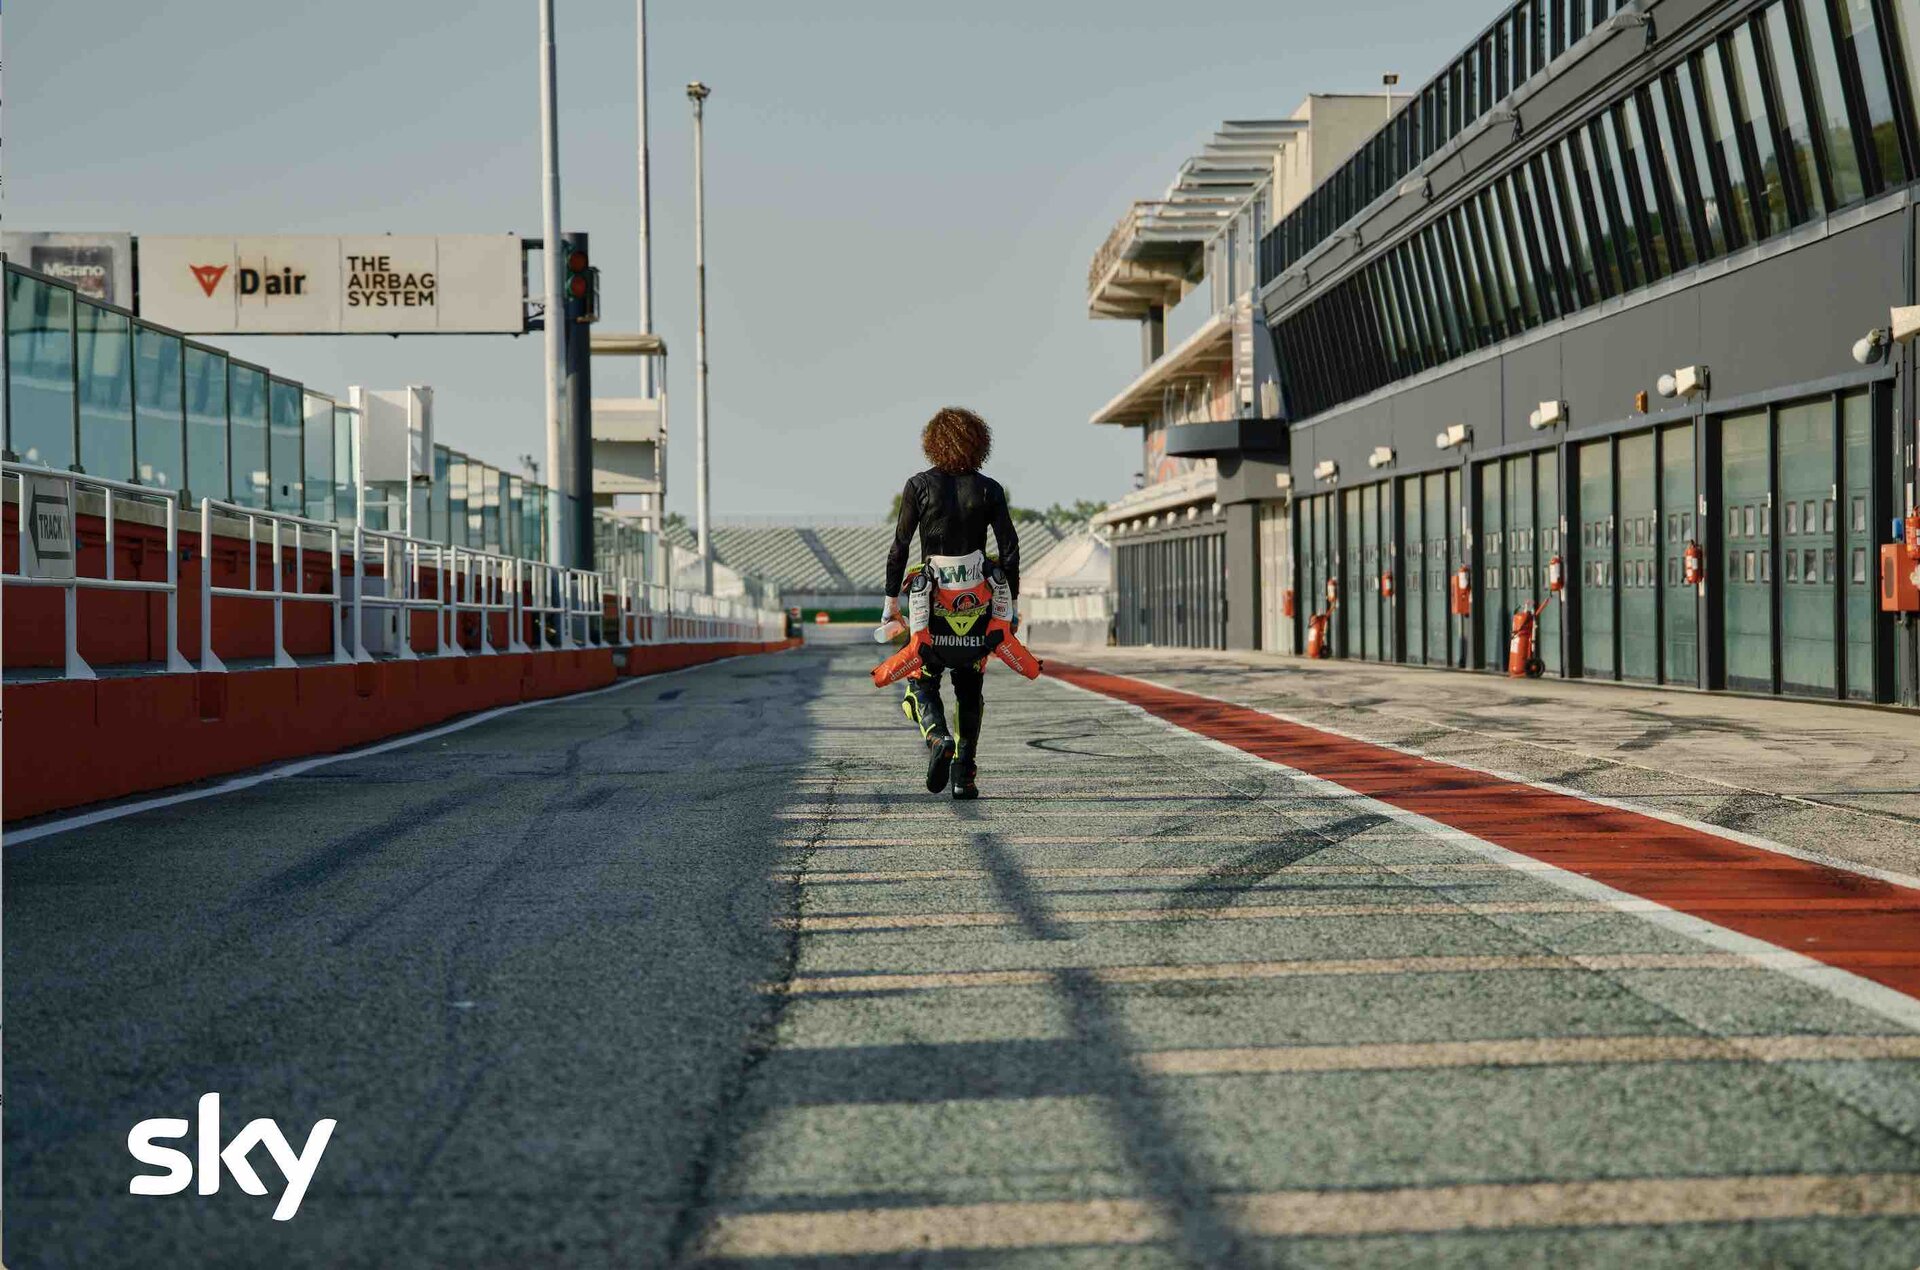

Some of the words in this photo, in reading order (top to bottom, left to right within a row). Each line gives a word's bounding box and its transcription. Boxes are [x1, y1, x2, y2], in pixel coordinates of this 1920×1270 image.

[42, 261, 105, 277] Misano
[347, 255, 391, 272] THE
[348, 273, 435, 290] AIRBAG
[348, 291, 435, 307] SYSTEM
[38, 514, 63, 540] TRACK
[1000, 643, 1024, 672] domino
[889, 656, 919, 681] domino
